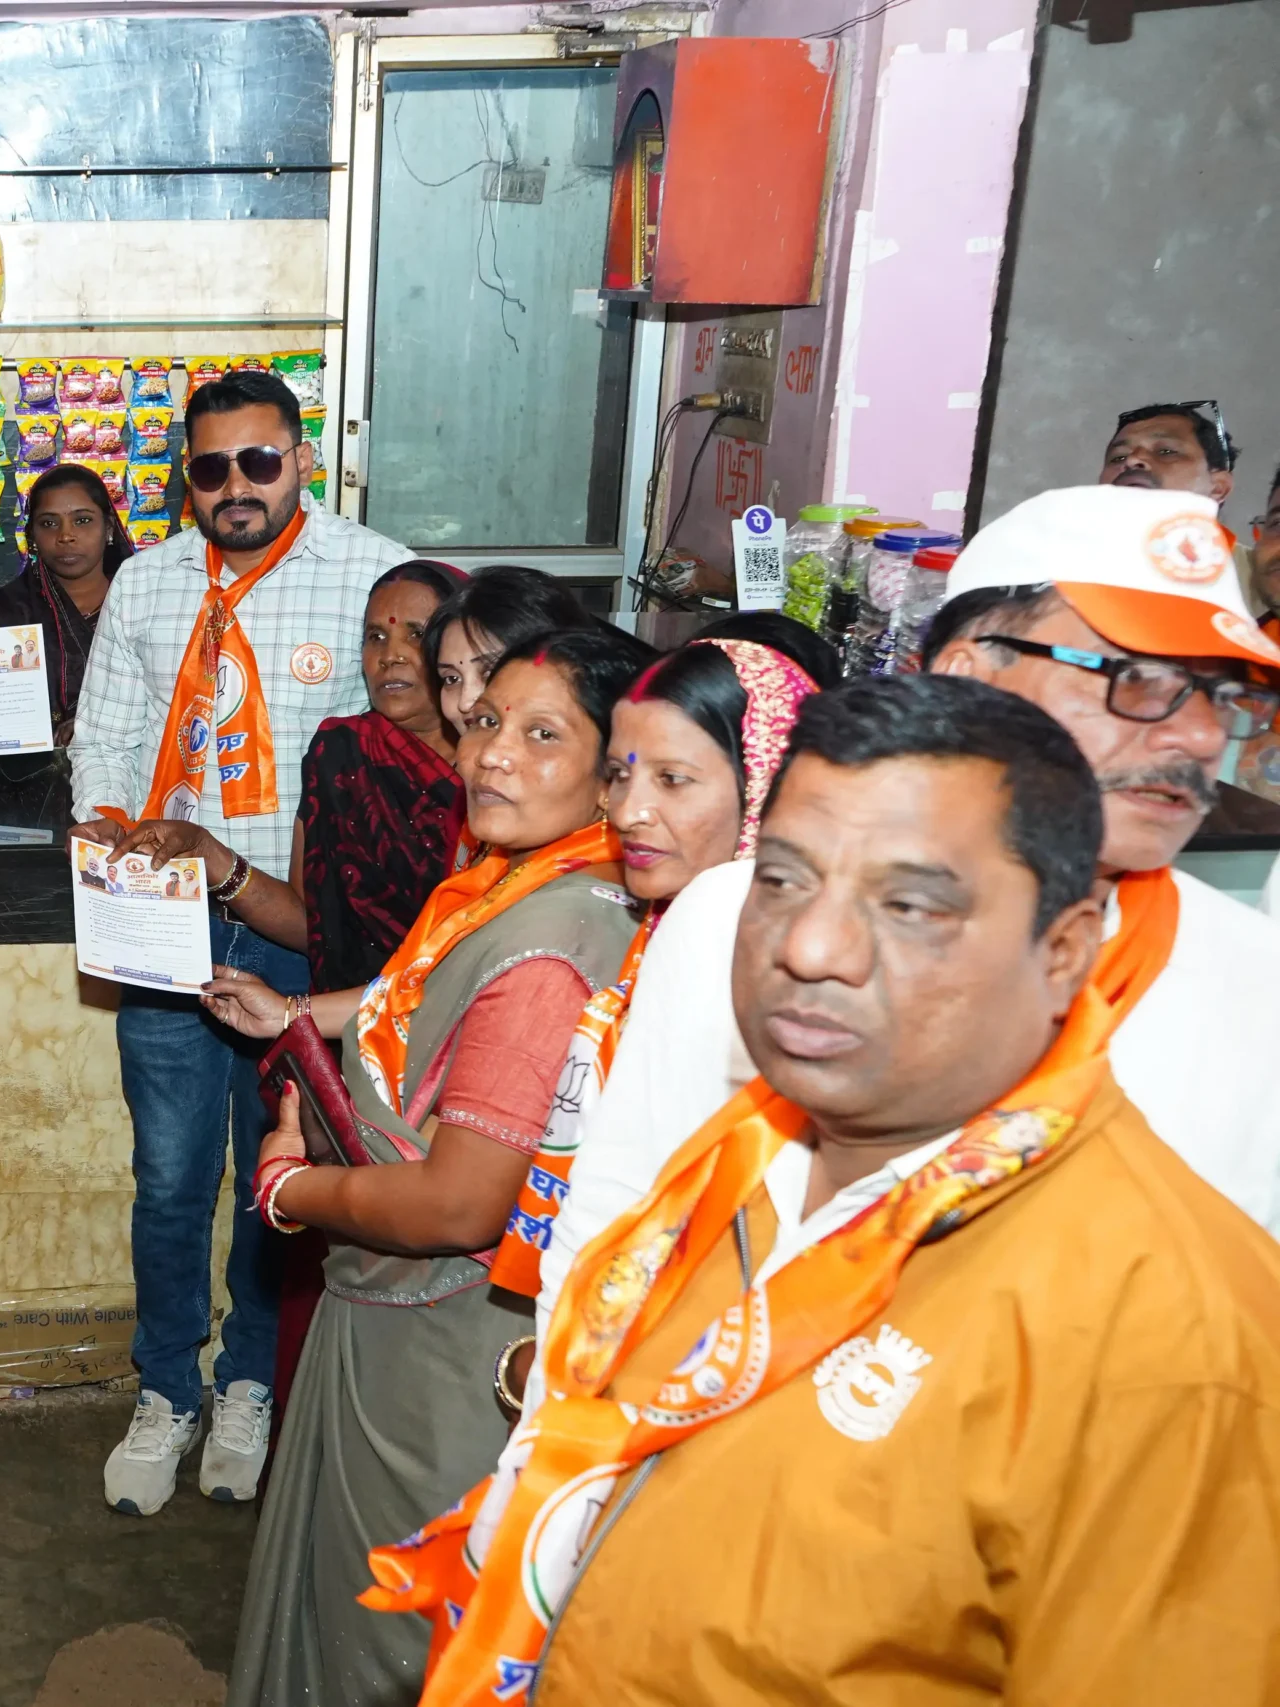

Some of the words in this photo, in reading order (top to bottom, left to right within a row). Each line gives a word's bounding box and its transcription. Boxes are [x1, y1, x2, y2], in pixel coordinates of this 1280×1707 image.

[752, 512, 765, 530] पे
[14, 1312, 50, 1327] Care
[55, 1310, 88, 1326] With
[94, 1308, 138, 1324] andle
